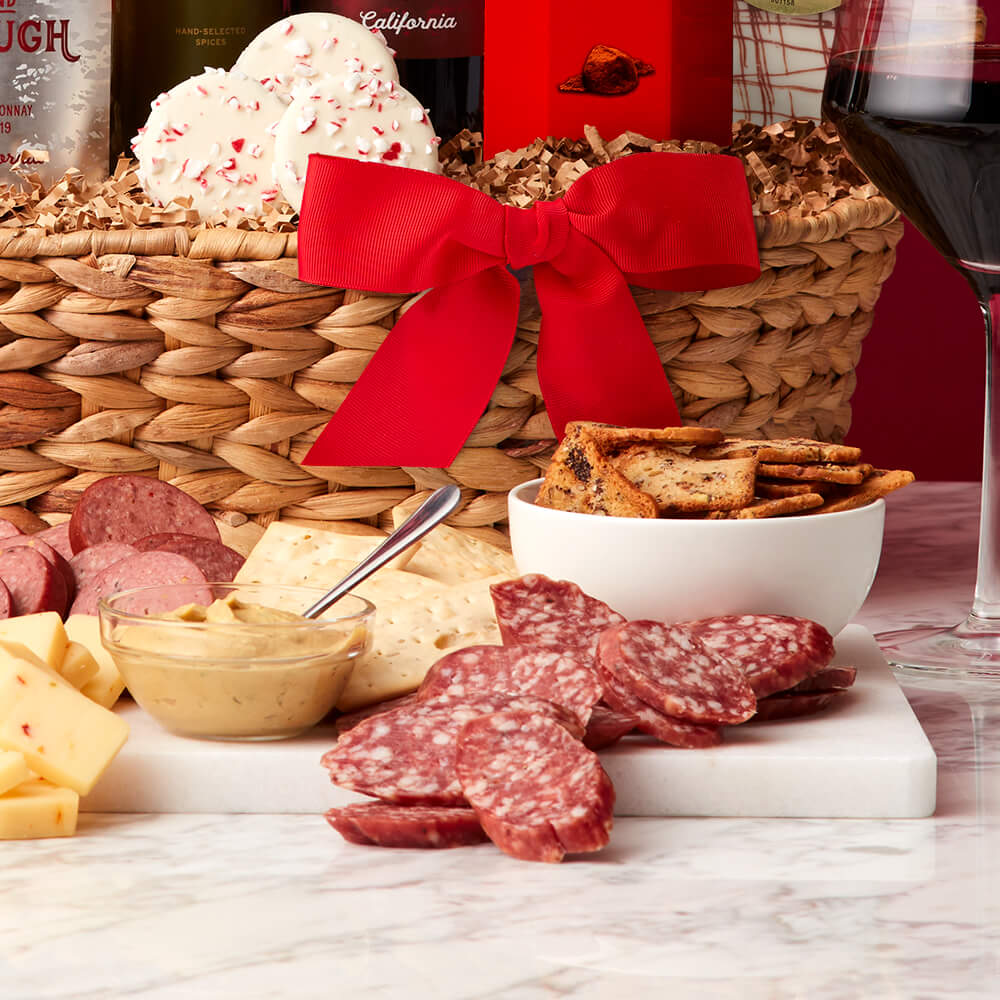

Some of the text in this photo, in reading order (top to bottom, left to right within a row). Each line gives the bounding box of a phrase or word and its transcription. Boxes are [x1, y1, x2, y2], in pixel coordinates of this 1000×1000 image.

[360, 10, 457, 35] California
[175, 27, 247, 35] HAND-SELECTED
[195, 38, 226, 46] SPICES
